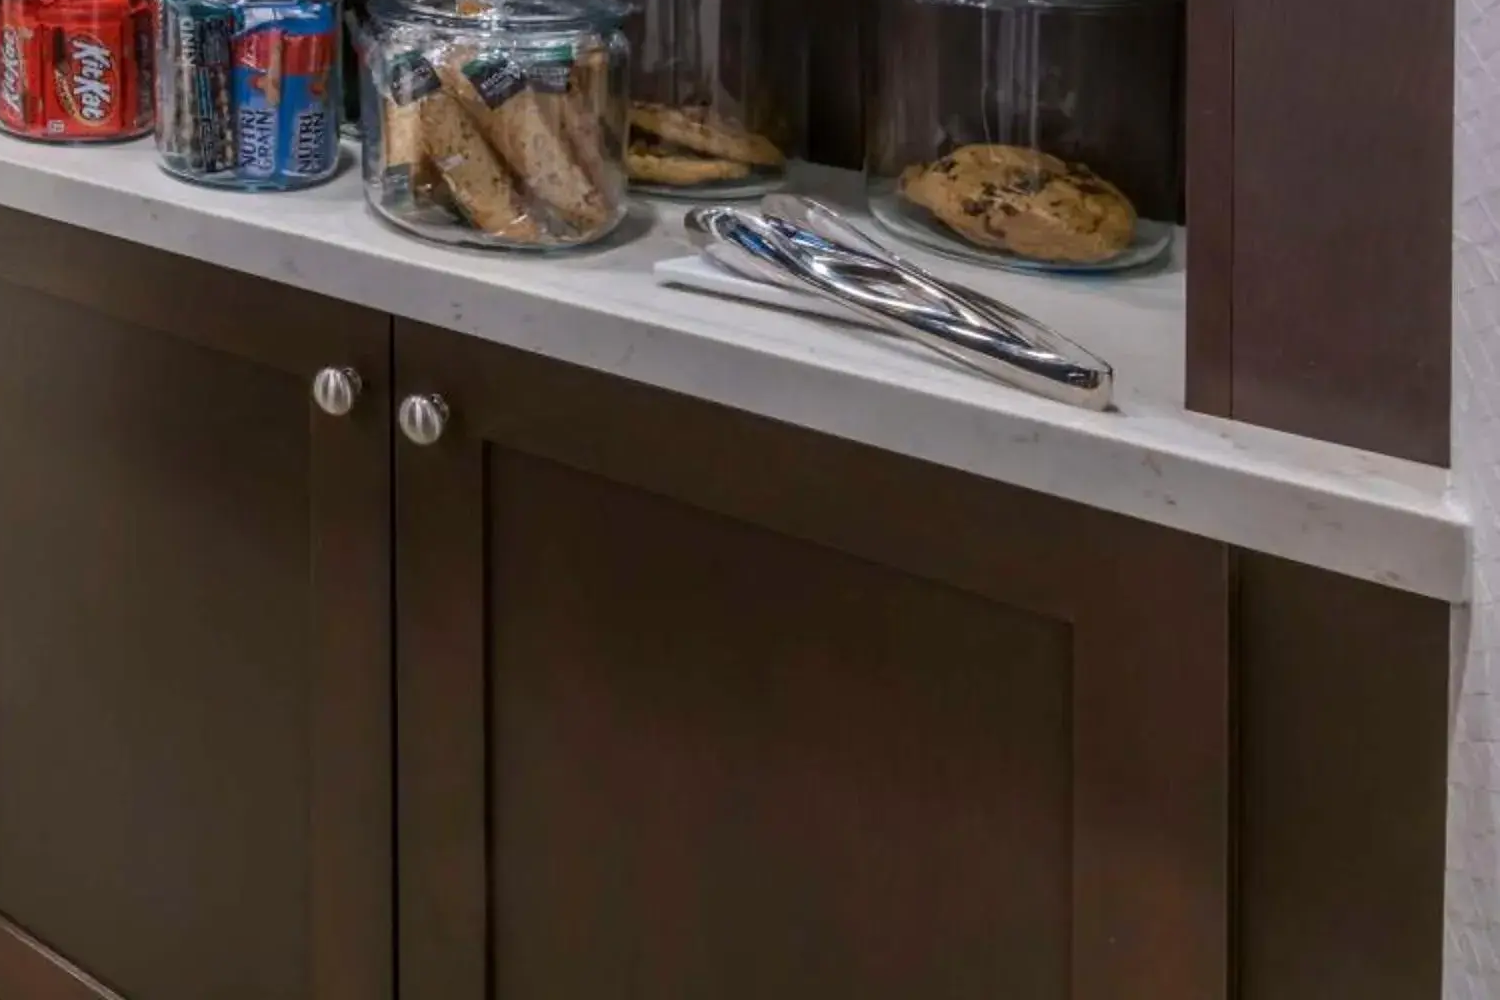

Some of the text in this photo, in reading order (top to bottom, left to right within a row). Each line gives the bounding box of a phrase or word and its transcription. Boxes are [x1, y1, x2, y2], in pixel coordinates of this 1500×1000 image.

[179, 16, 196, 67] KIND
[241, 107, 255, 168] NUTRI
[255, 110, 275, 171] GRAIN
[299, 112, 313, 173] NUTRI
